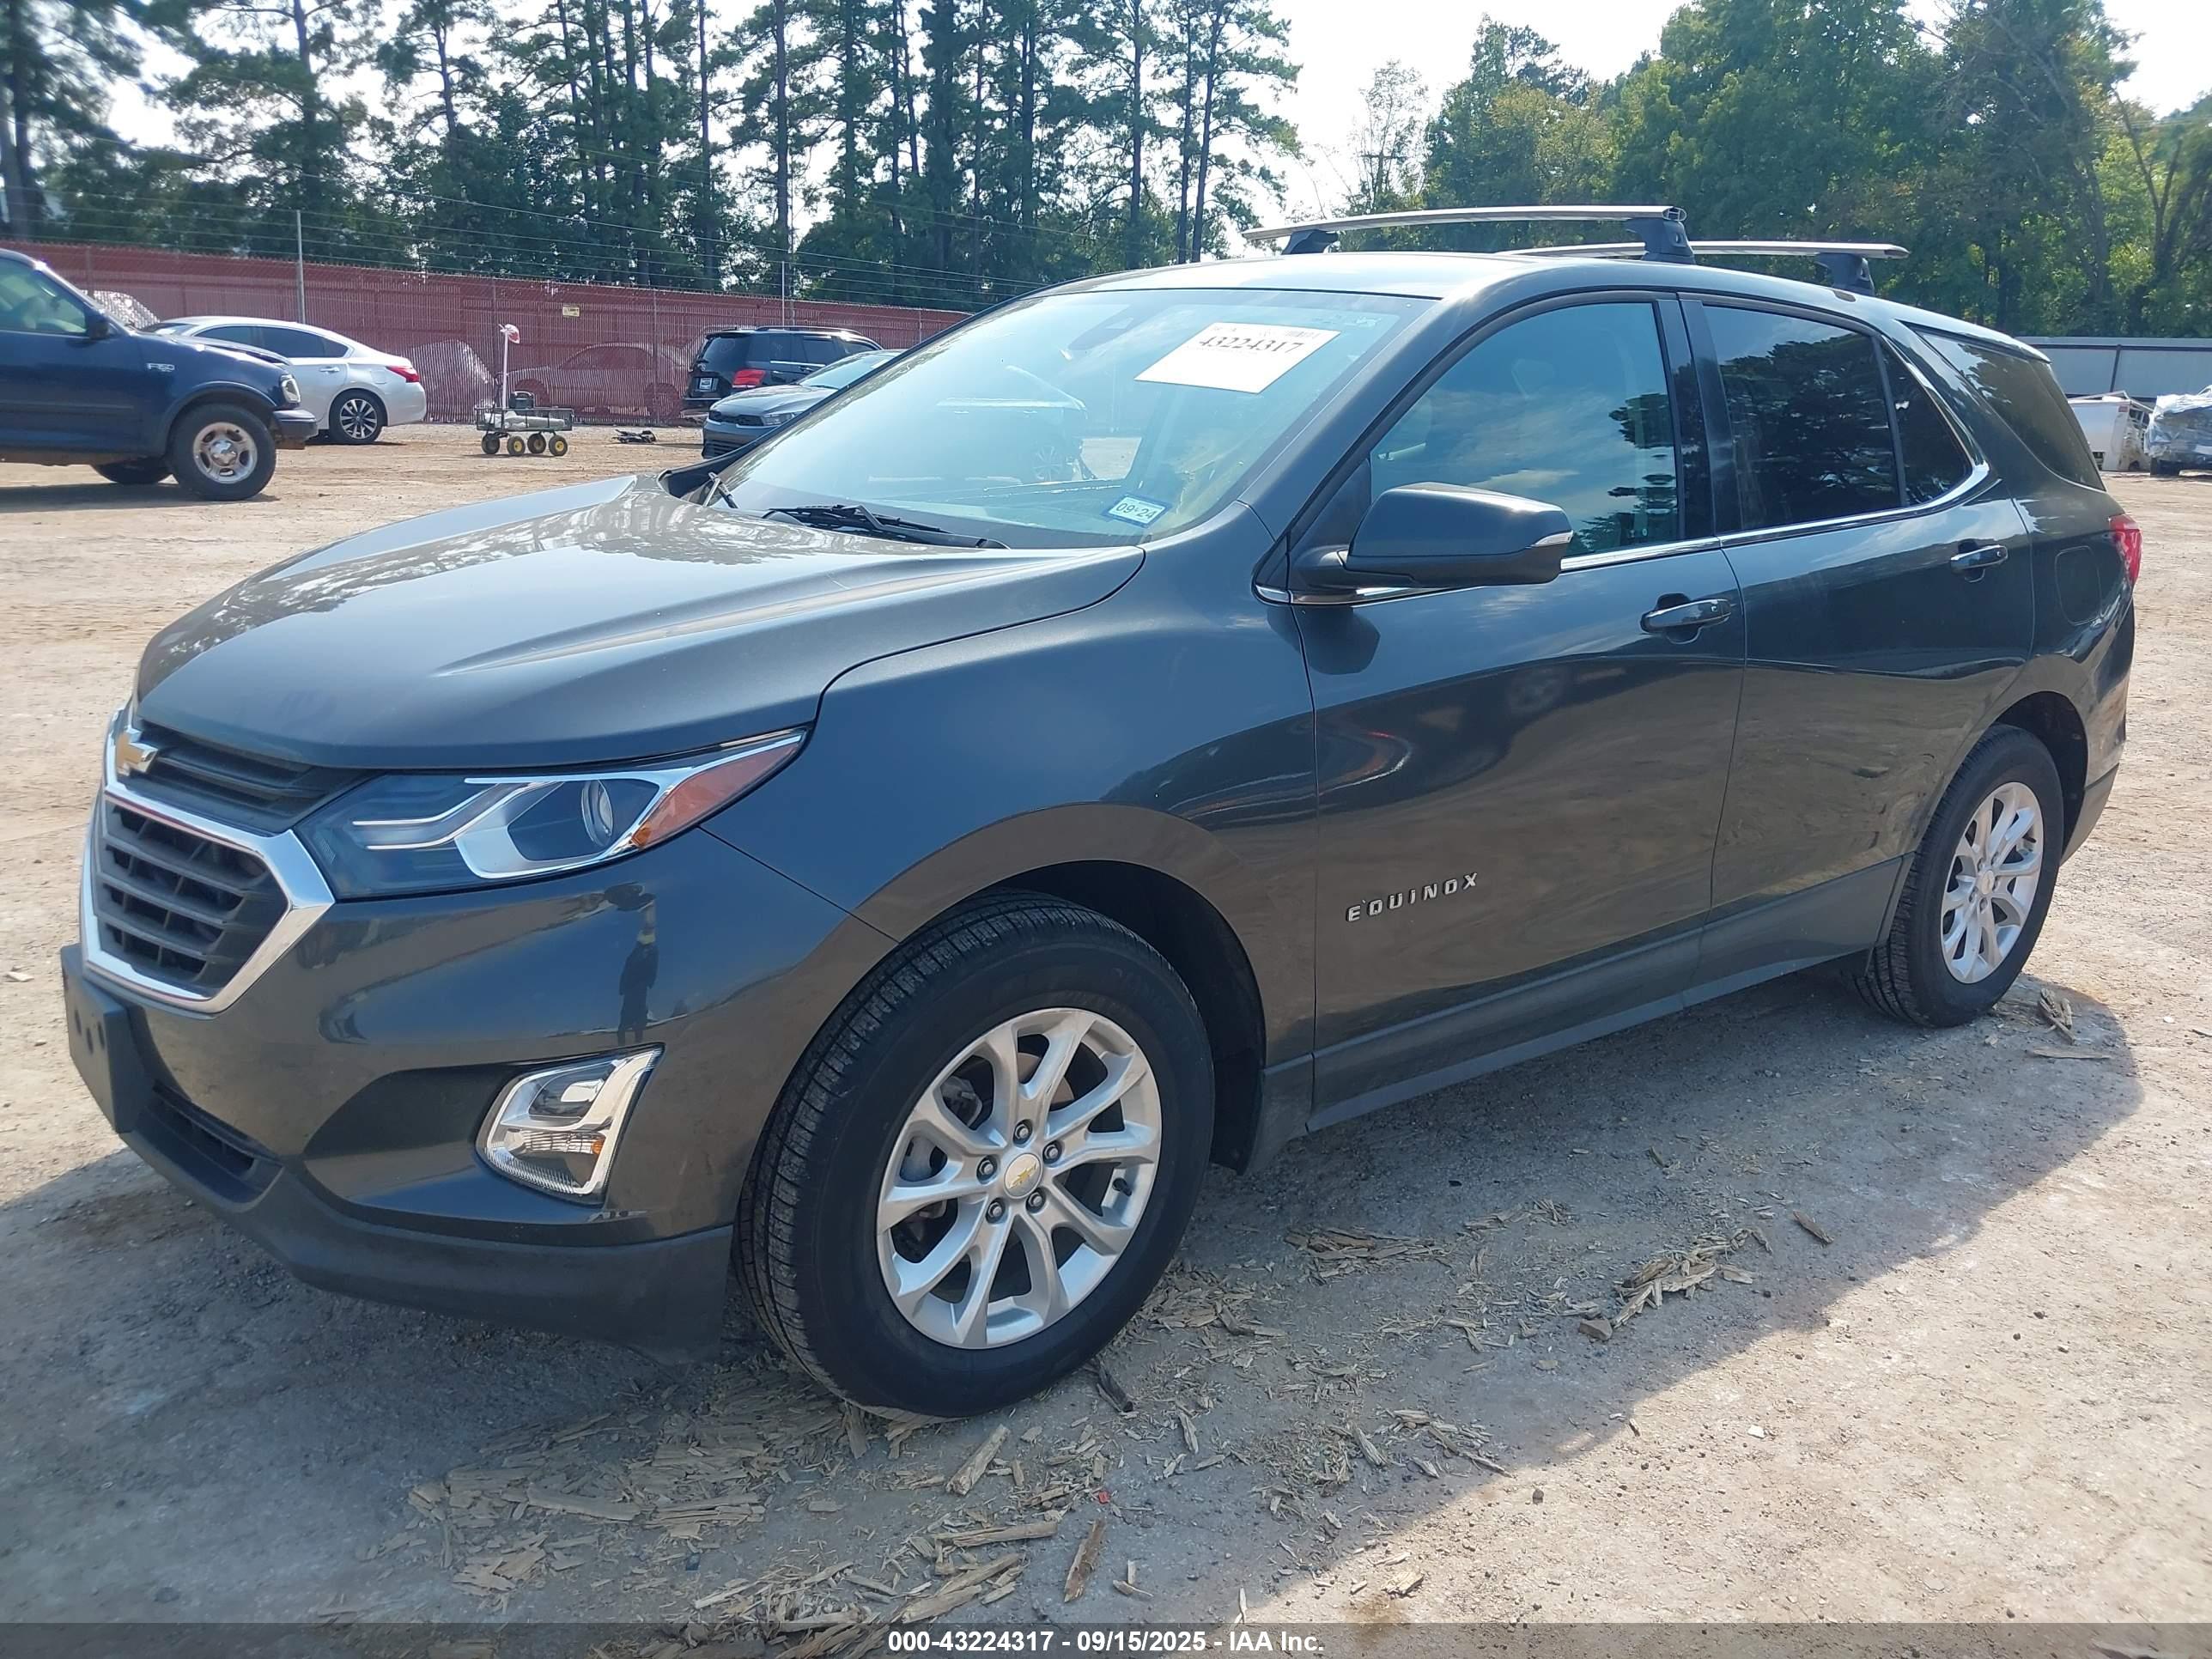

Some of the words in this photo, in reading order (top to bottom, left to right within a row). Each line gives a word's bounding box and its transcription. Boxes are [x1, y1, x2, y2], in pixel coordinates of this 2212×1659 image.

[1200, 336, 1304, 354] 43224317
[1115, 502, 1135, 514] 09
[1136, 507, 1158, 520] 24
[1346, 872, 1478, 922] EQUINOX
